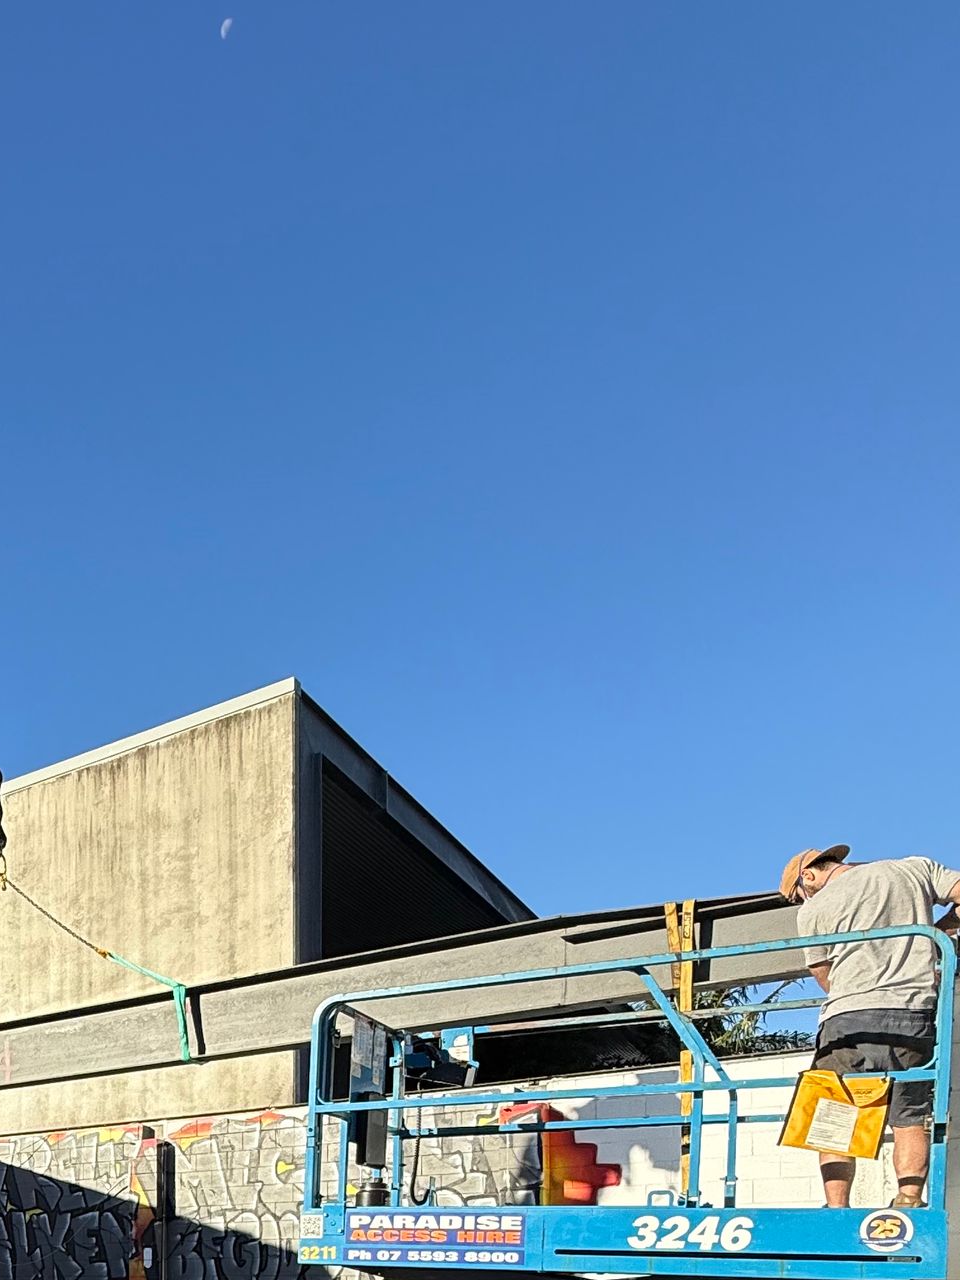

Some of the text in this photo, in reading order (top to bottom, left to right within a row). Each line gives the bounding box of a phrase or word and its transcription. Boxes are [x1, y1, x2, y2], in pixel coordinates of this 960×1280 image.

[349, 1215, 523, 1231] PARADISE
[869, 1218, 902, 1239] 25
[350, 1229, 521, 1244] ACCESS HIRE
[626, 1215, 755, 1251] 3246
[300, 1246, 337, 1261] 3211
[347, 1249, 519, 1262] Ph 07 5593 8900
